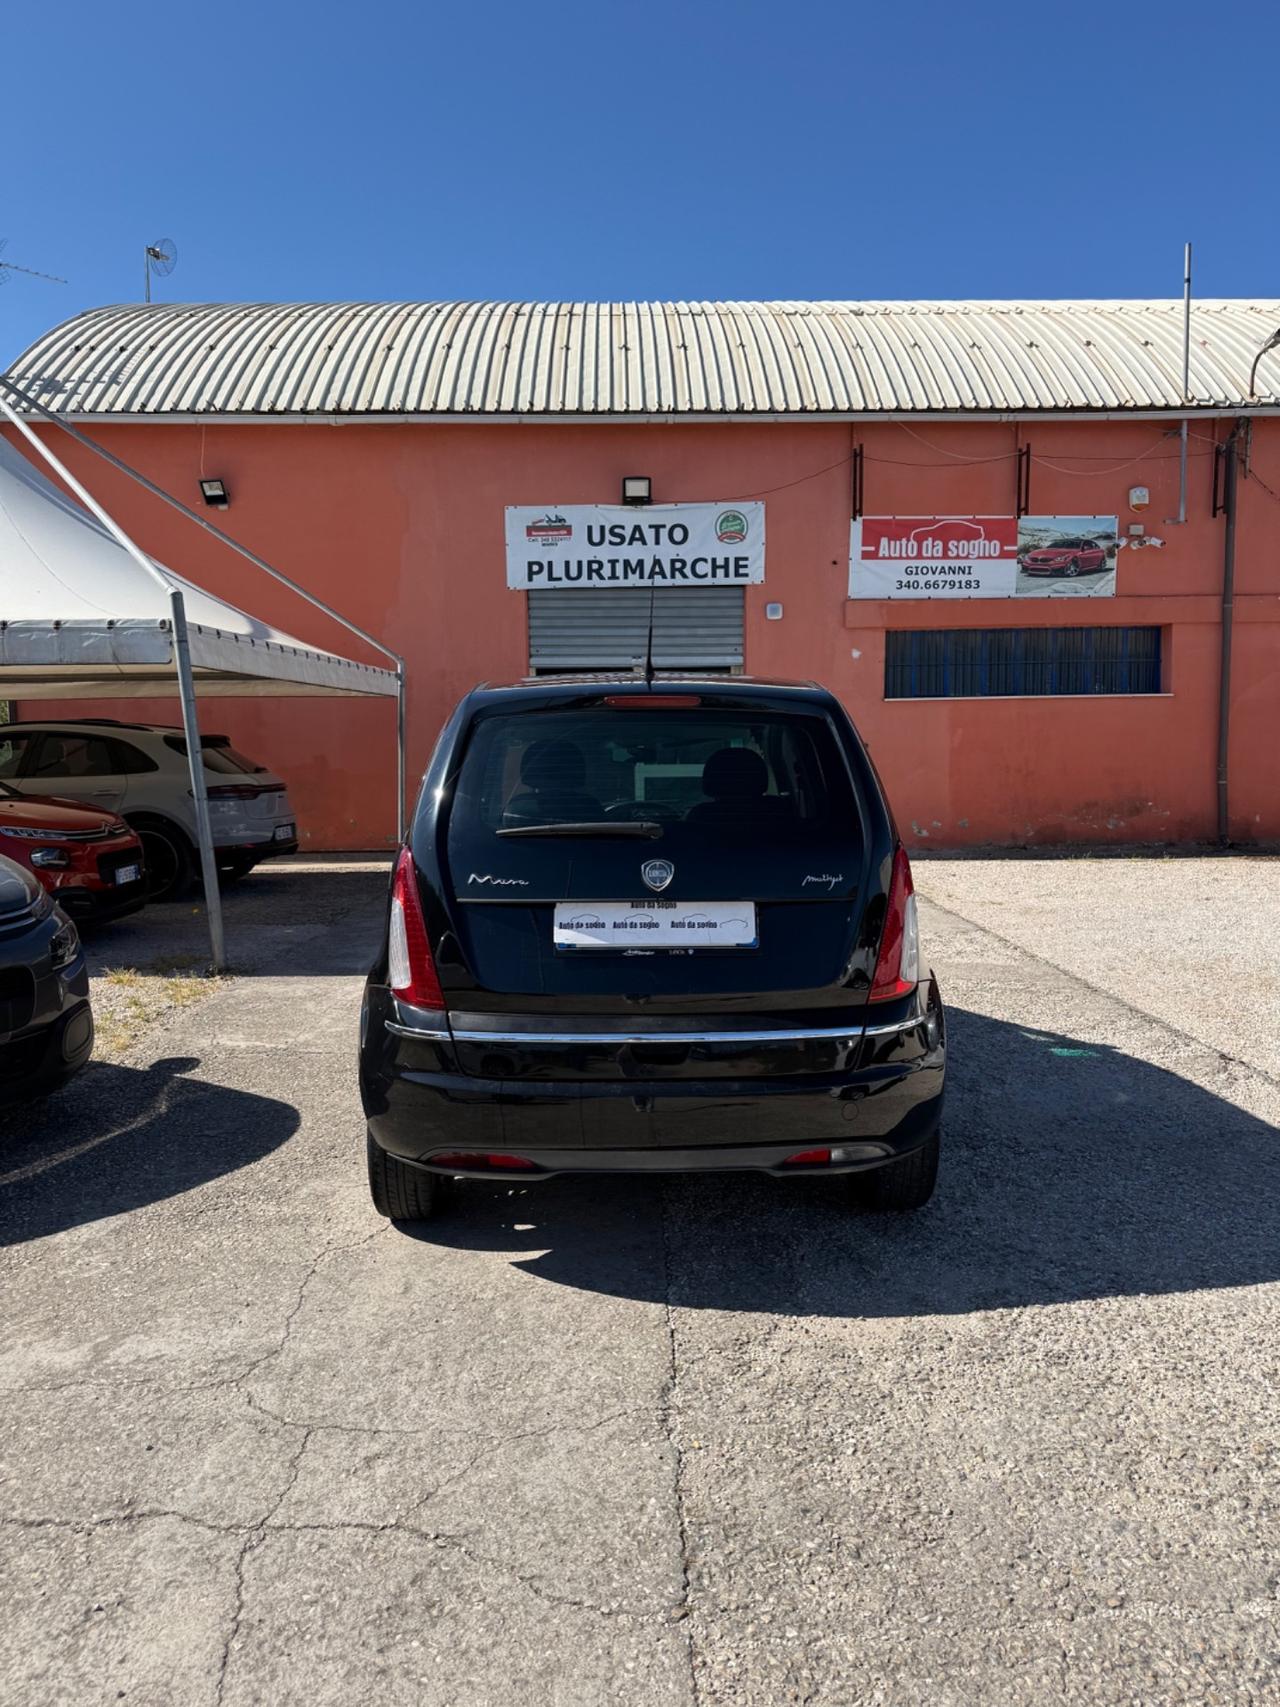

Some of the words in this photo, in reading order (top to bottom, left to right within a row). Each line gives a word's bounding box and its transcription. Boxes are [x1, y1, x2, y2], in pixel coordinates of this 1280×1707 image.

[587, 523, 689, 546] USATO
[879, 537, 918, 558] Auto
[922, 537, 944, 558] da
[948, 539, 1001, 559] sogno
[527, 556, 749, 582] PLURIMARCHE
[904, 565, 973, 576] GIOVANNI
[895, 579, 981, 590] 340.6679183
[559, 921, 574, 930] Auto
[613, 921, 628, 929] Auto
[629, 921, 638, 929] da
[639, 921, 660, 930] sogno
[670, 920, 686, 929] Auto
[687, 921, 696, 929] da
